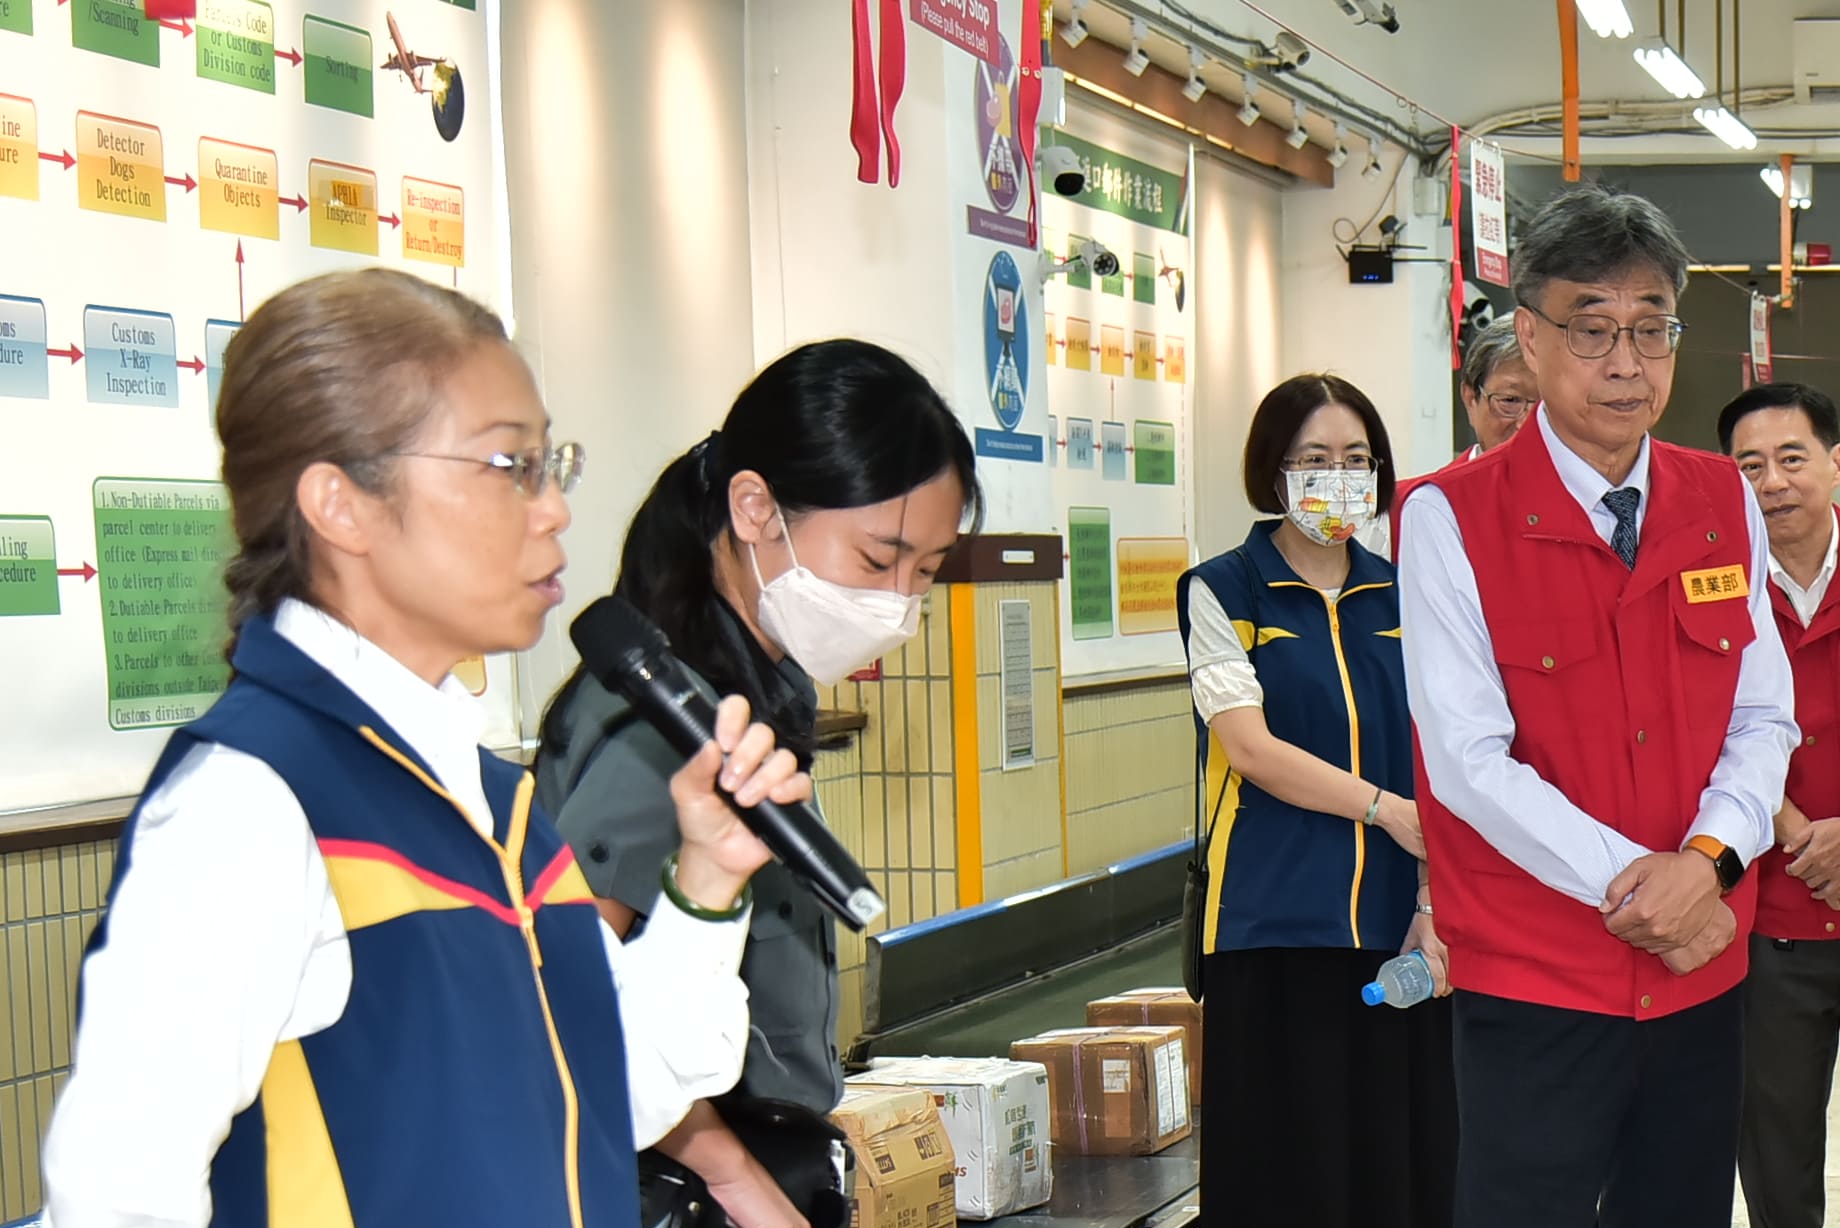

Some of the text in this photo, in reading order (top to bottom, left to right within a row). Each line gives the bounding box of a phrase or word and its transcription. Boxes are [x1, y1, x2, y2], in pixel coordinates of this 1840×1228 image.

[211, 31, 262, 56] or Customs
[204, 51, 270, 82] Division code
[326, 56, 359, 83] Sorting
[97, 128, 144, 156] Detector
[110, 156, 134, 181] Dogs
[215, 158, 268, 186] Quarantine
[96, 179, 151, 207] Detection
[224, 184, 261, 208] Objects
[407, 188, 460, 216] Re-inspection
[326, 205, 367, 226] Inspector
[112, 323, 156, 346] Customs
[120, 348, 152, 373] X-Ray
[107, 373, 166, 397] Inspection
[103, 520, 133, 538] parcel
[139, 523, 169, 536] center
[104, 546, 137, 563] office
[122, 573, 163, 592] delivery
[1691, 573, 1739, 597] 農業部
[119, 600, 160, 616] Dutiable
[127, 627, 168, 645] delivery
[124, 654, 159, 671] Parcels
[116, 681, 160, 698] divisions
[116, 708, 151, 725] Customs
